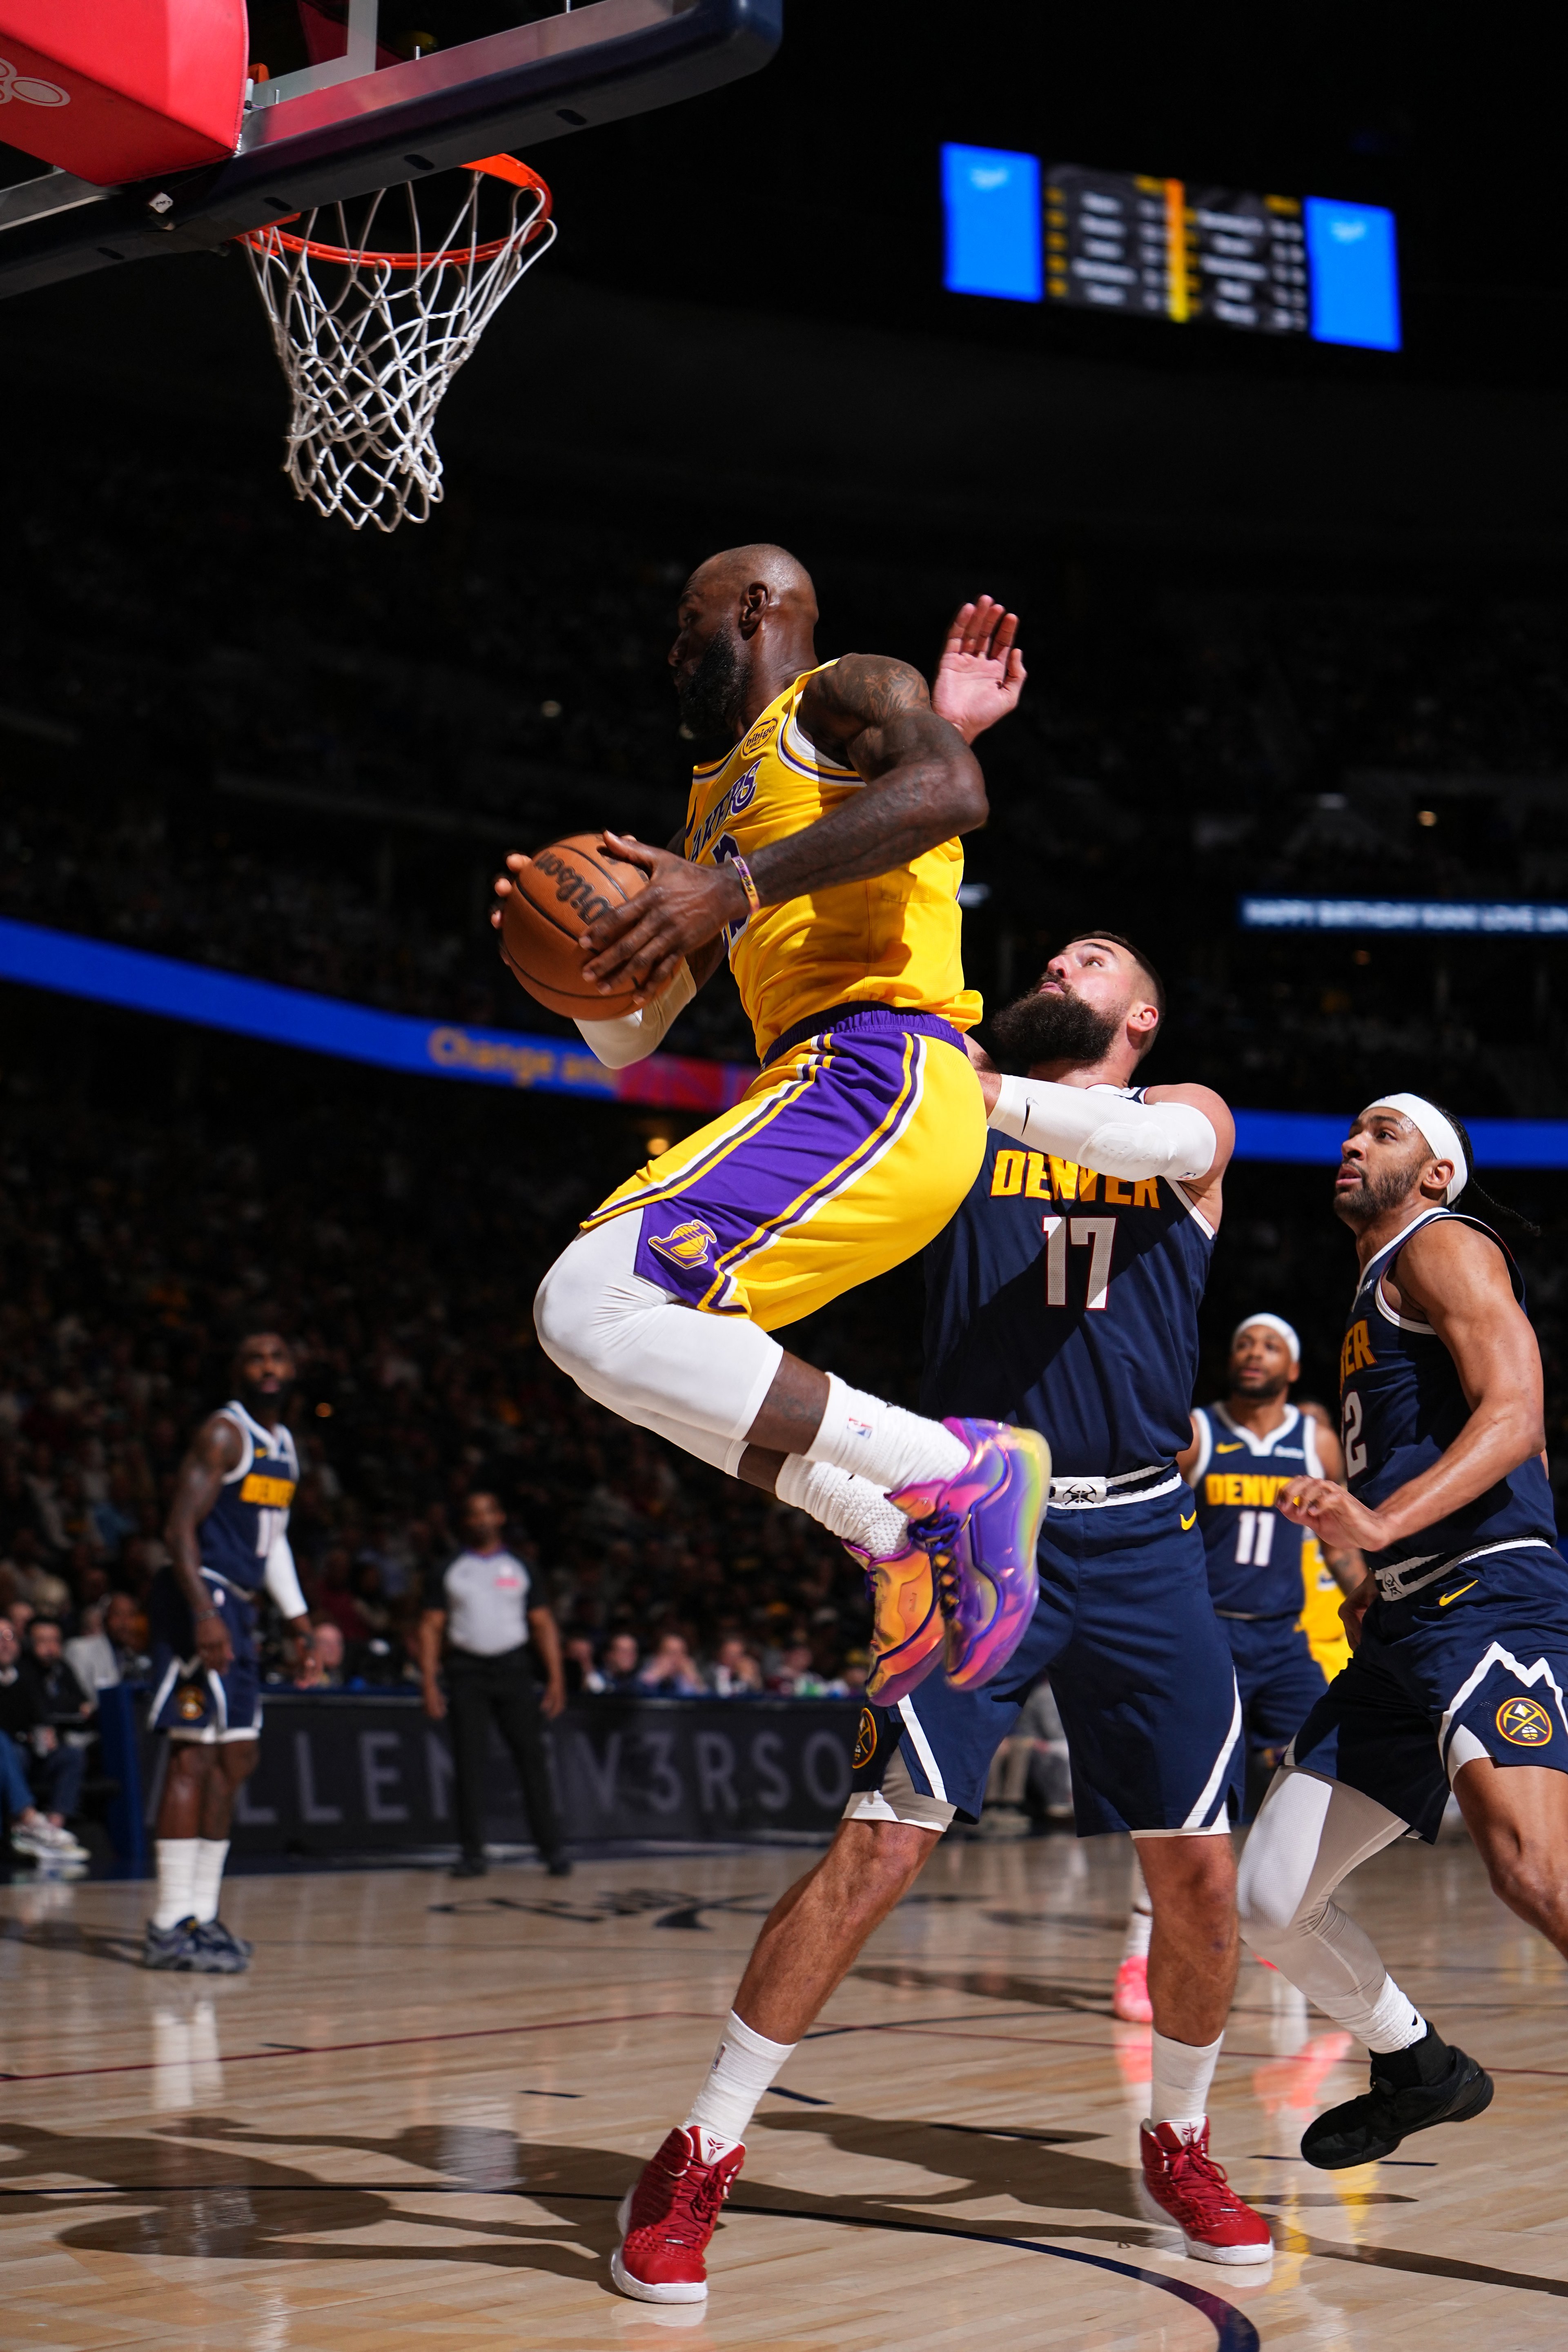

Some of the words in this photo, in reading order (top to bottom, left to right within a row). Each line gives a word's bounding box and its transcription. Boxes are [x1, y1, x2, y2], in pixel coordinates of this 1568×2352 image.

[746, 725, 775, 747] bibigo
[688, 759, 763, 862] AKERS
[990, 1149, 1161, 1210] DENVER
[1042, 1215, 1119, 1311] 17
[1341, 1390, 1368, 1480] 2
[1205, 1473, 1295, 1508] DENV
[1235, 1510, 1276, 1567] 11
[142, 1731, 456, 1826] LLEN
